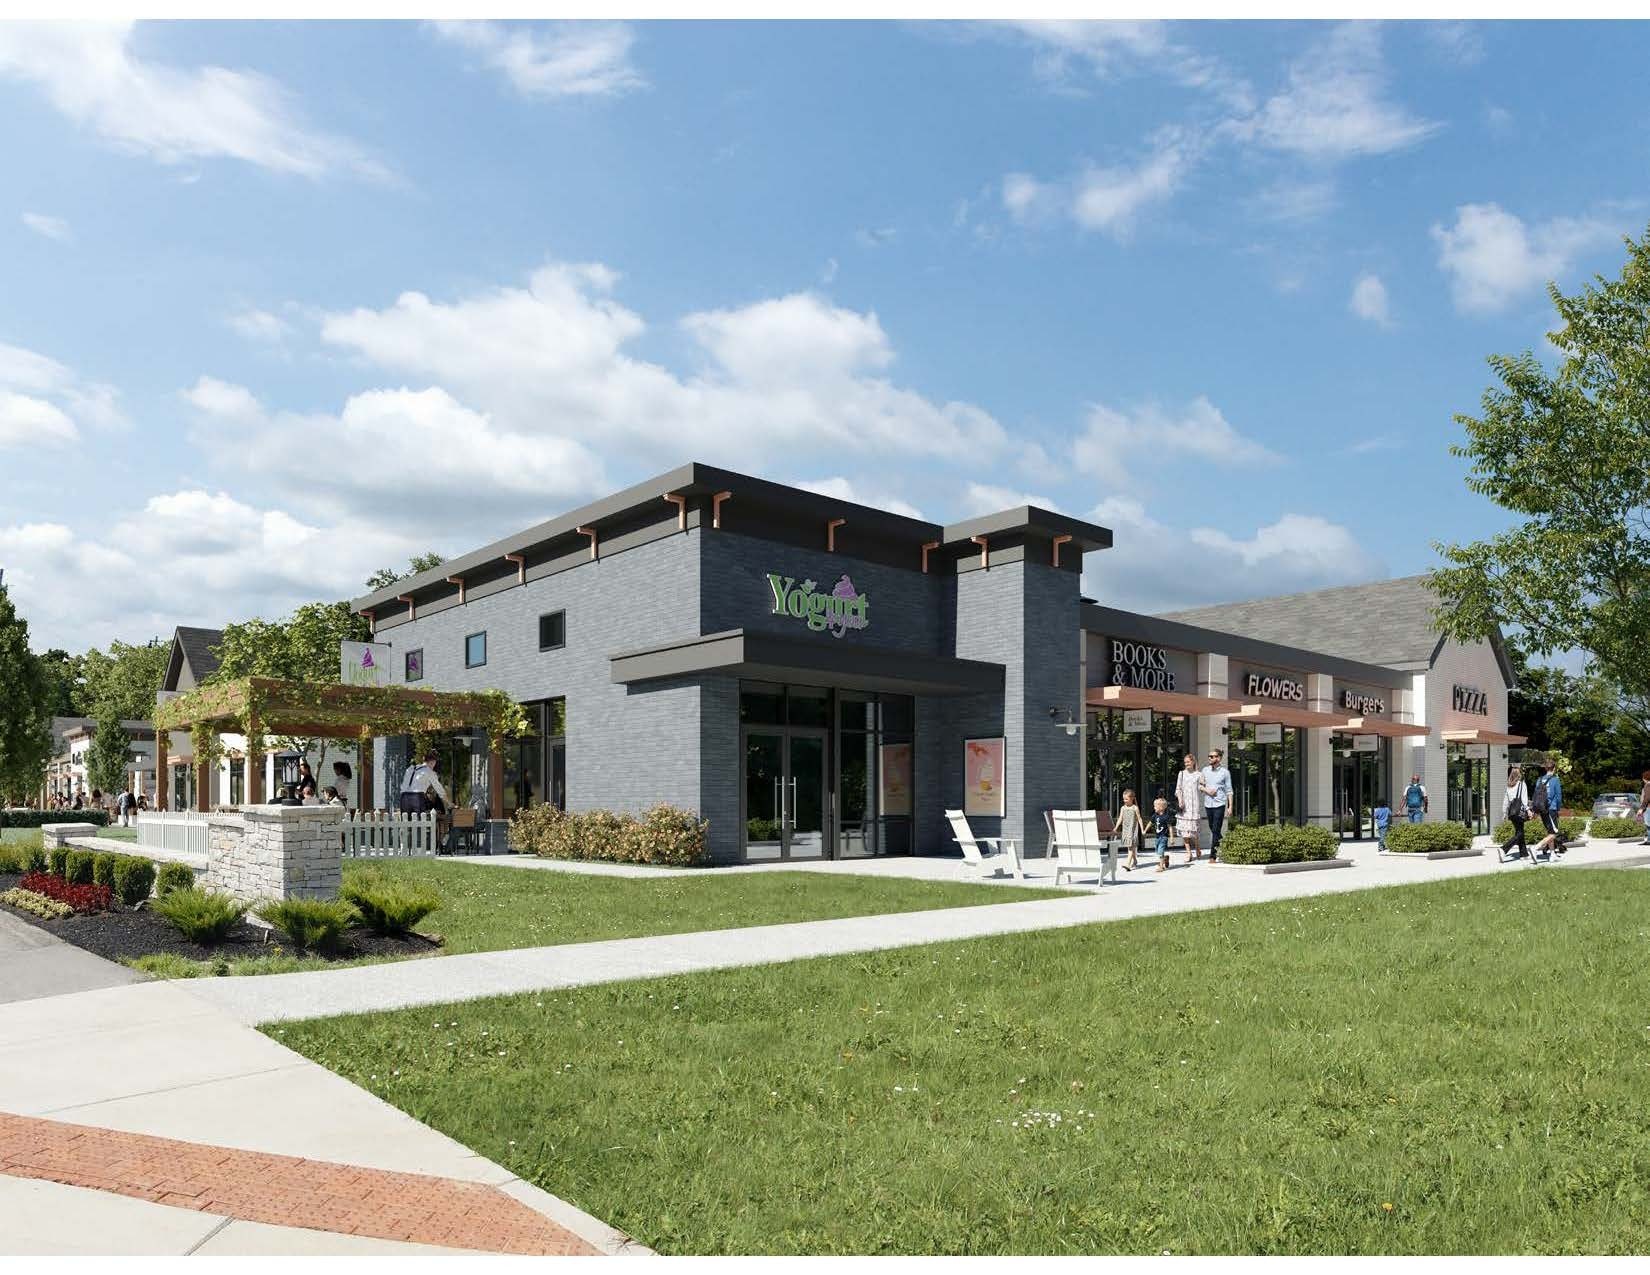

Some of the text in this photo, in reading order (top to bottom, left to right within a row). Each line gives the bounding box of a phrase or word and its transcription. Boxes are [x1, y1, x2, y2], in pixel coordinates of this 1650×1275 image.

[766, 573, 869, 632] Yogurt
[1112, 640, 1167, 670] BOOKS
[1112, 664, 1176, 692] & MORE
[1249, 674, 1304, 701] FLOWERS
[1345, 690, 1385, 715] Burgers
[1453, 684, 1489, 716] PIZZA
